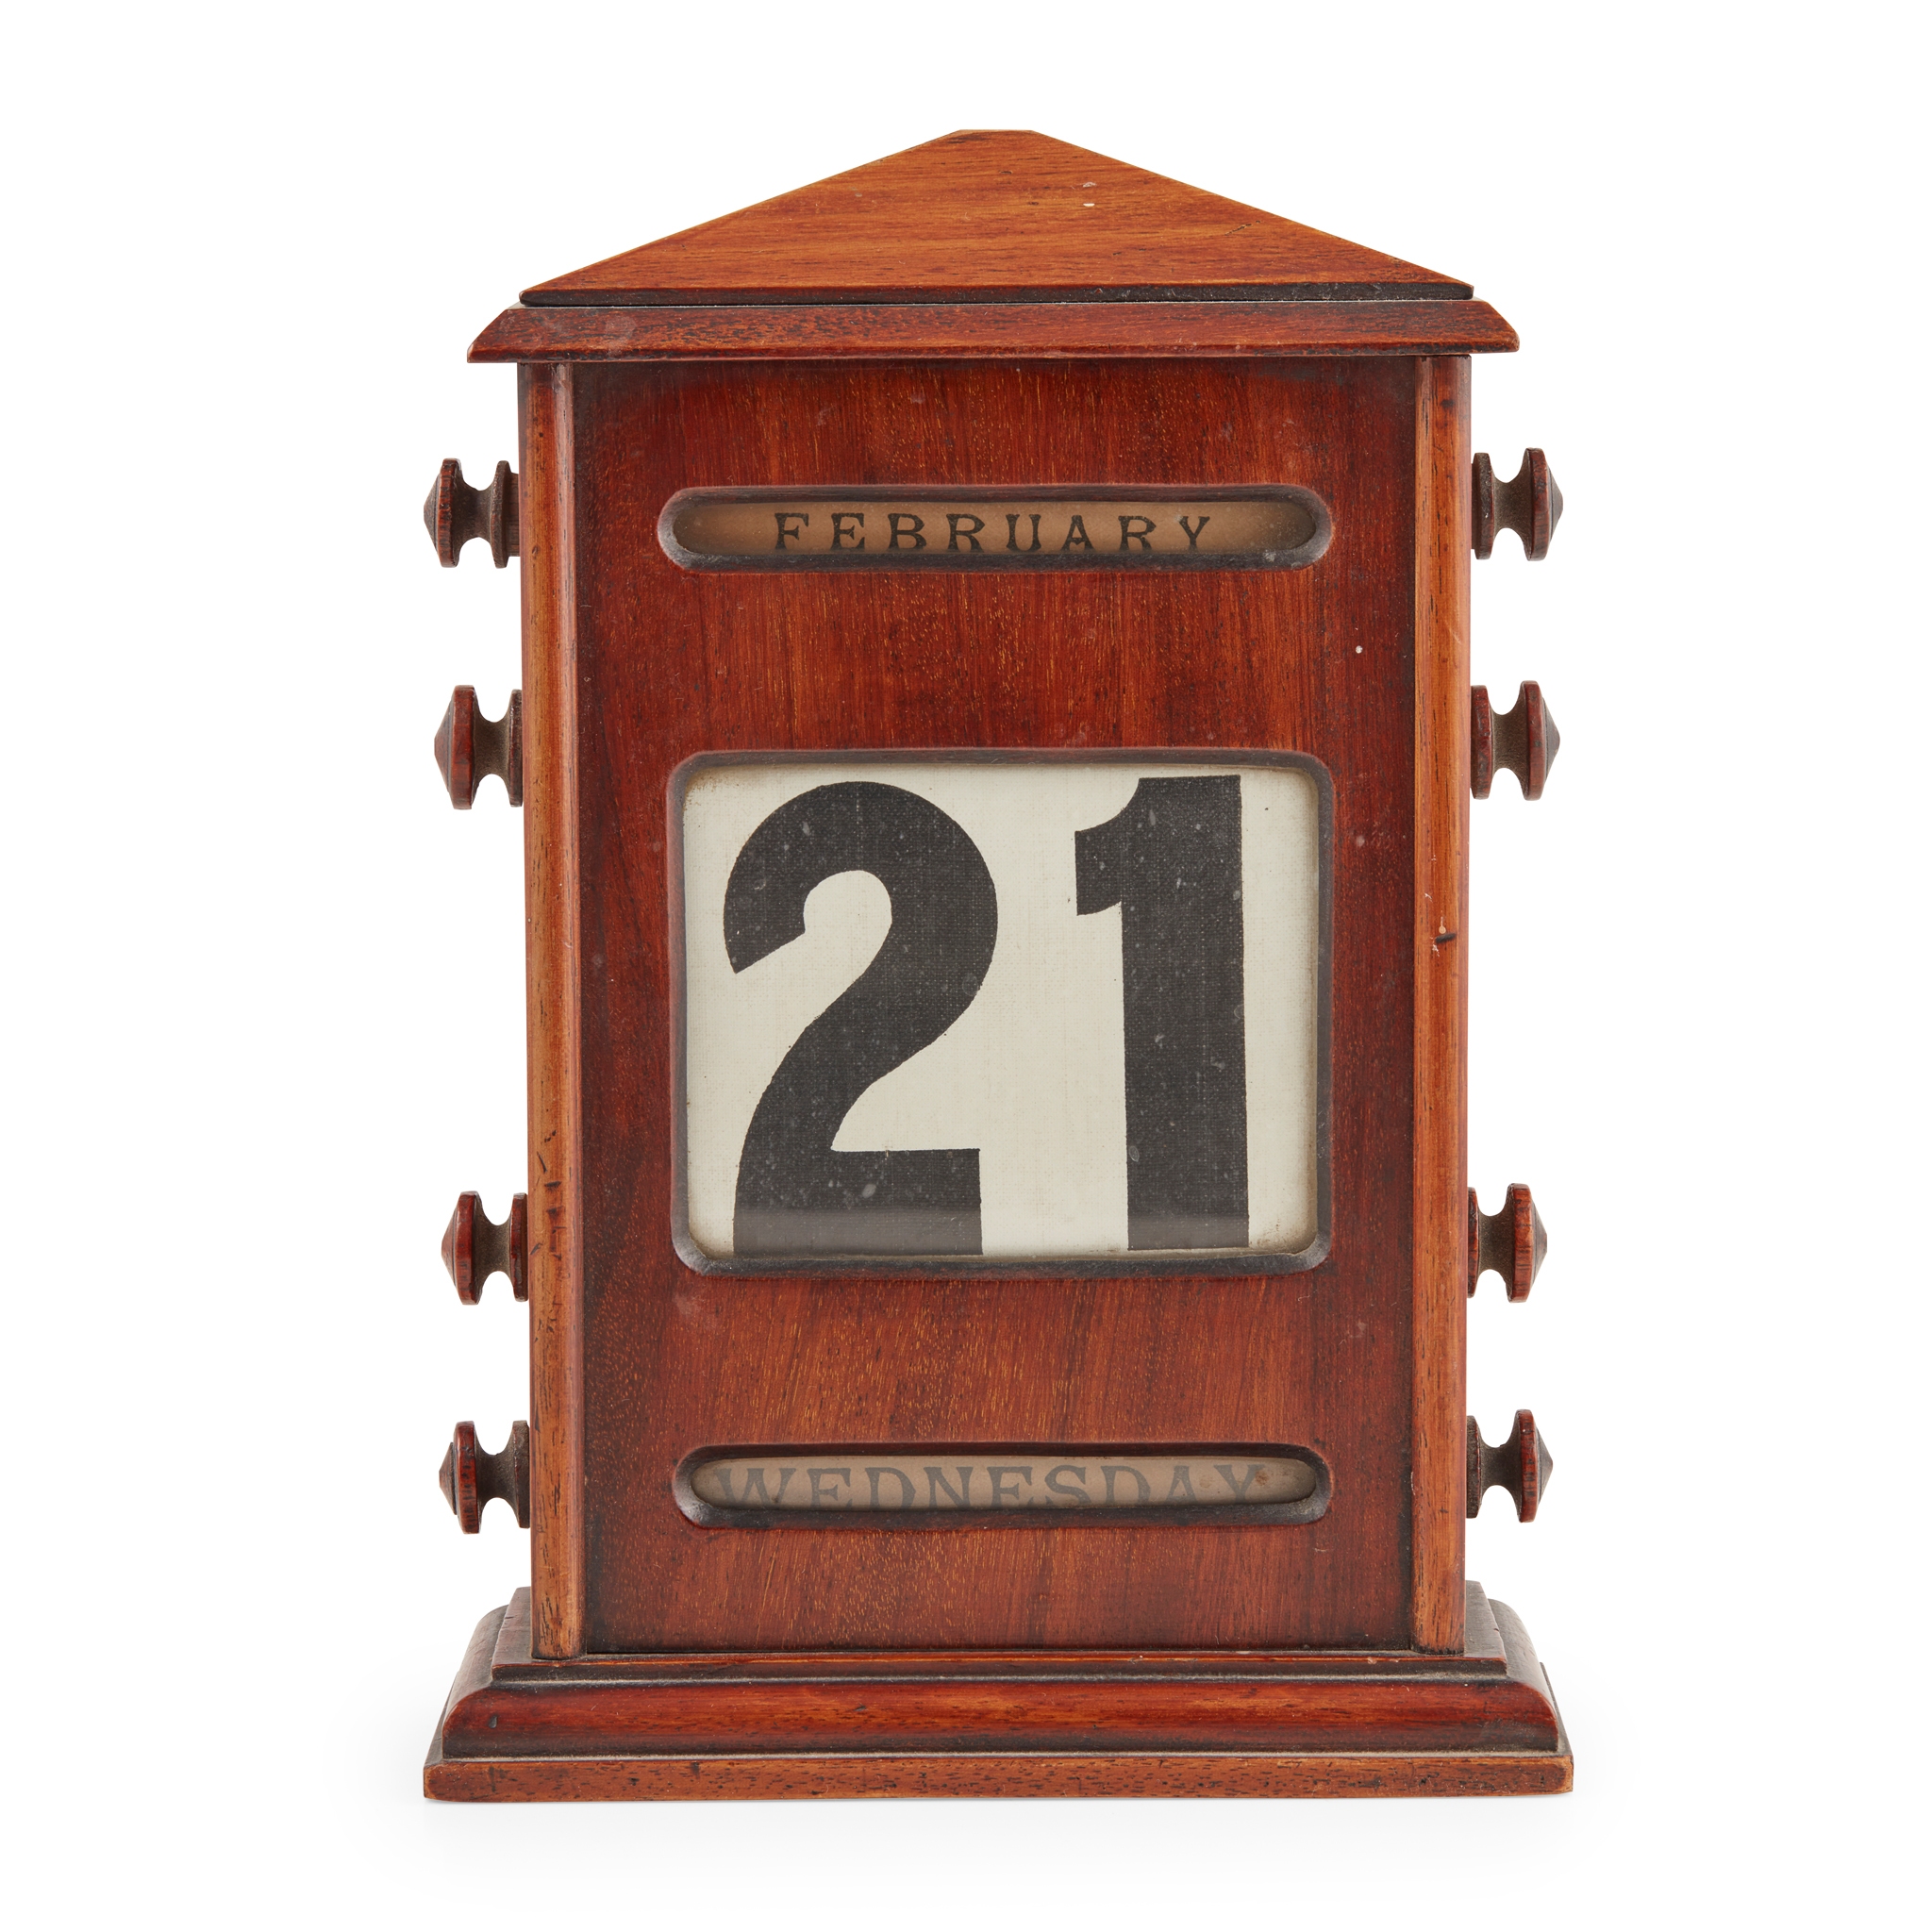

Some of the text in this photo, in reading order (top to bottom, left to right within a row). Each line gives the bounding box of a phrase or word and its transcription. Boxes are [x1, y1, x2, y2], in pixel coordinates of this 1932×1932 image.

[774, 512, 1210, 552] FEBRUARY
[724, 774, 1250, 1256] 21
[717, 1464, 1269, 1507] WEDNESDAY
